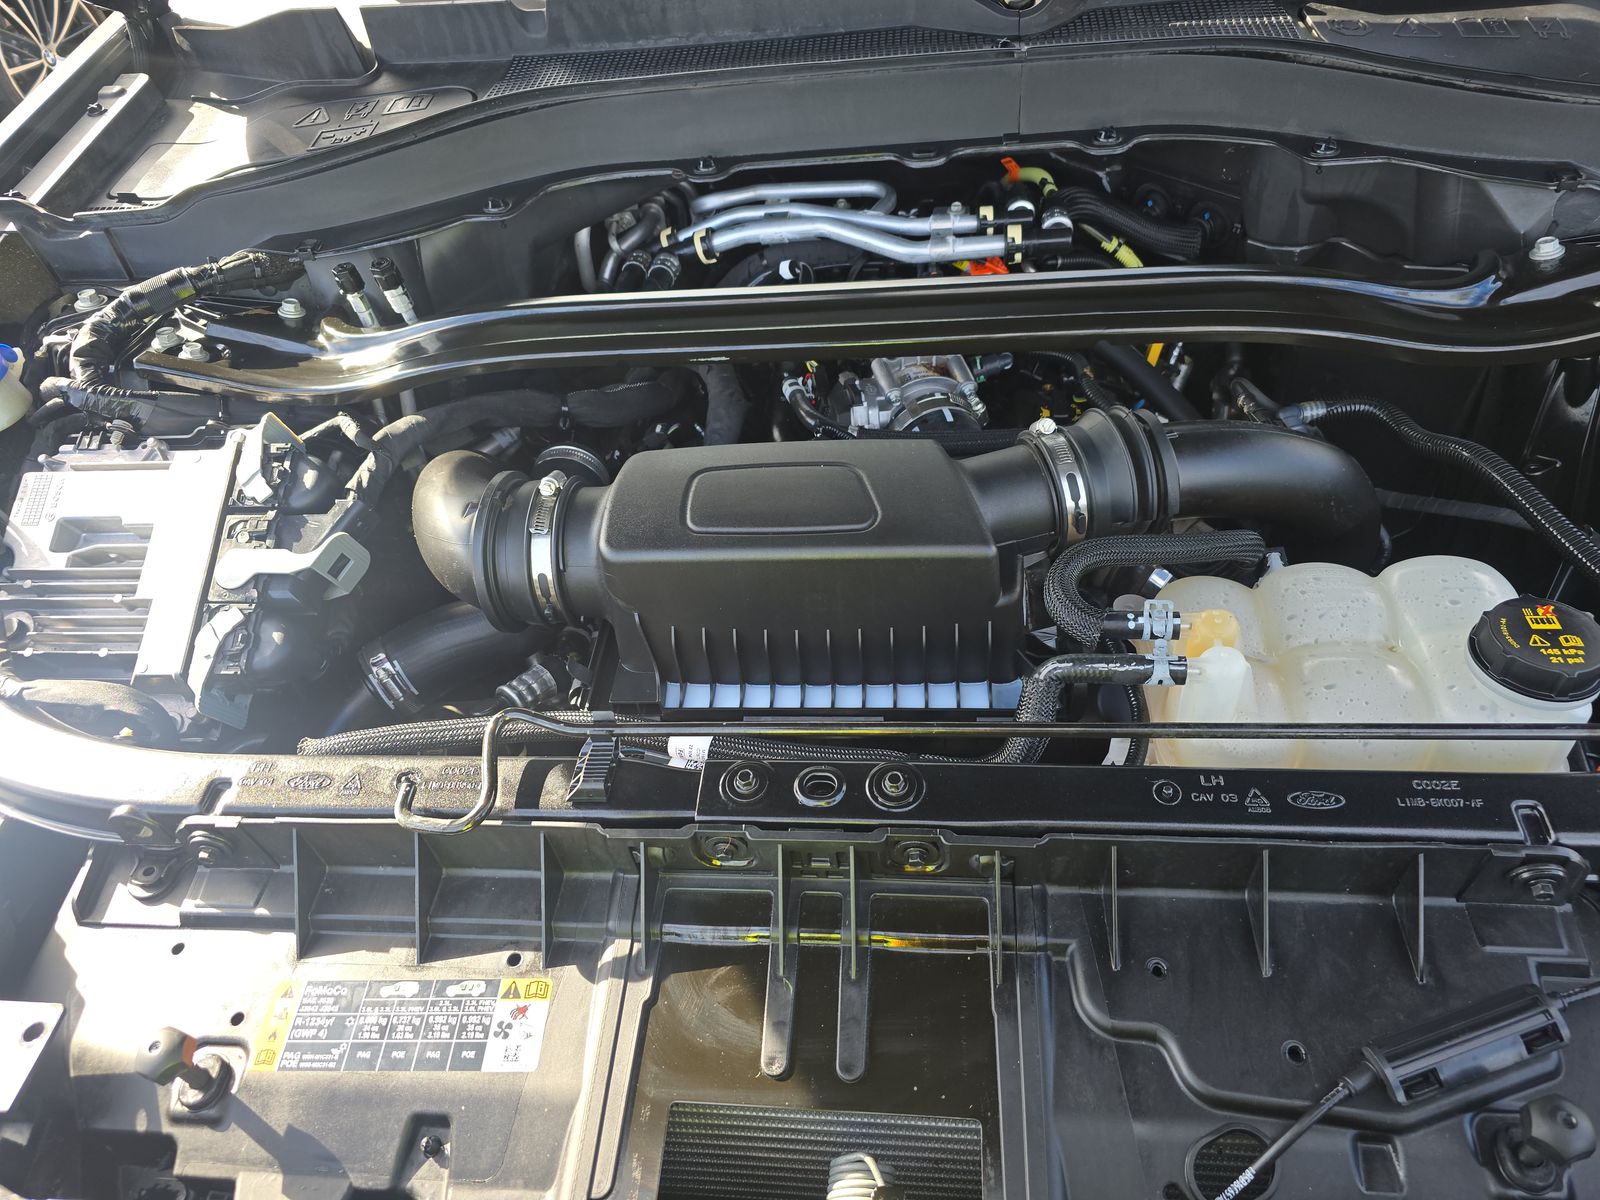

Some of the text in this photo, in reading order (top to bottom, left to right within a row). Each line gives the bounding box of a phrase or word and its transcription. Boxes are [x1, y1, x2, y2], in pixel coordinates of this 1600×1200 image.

[1566, 656, 1585, 665] psi
[1200, 775, 1225, 786] LH
[1412, 780, 1461, 790] C002E
[1191, 793, 1239, 803] CAV 03
[1293, 791, 1341, 808] Ford
[303, 984, 348, 997] FoMoCo
[294, 1016, 336, 1028] R-1234yf
[411, 1016, 421, 1026] kg
[448, 1015, 457, 1025] kg
[482, 1015, 491, 1025] kg
[282, 1051, 301, 1060] PAG
[280, 1060, 299, 1068] POE
